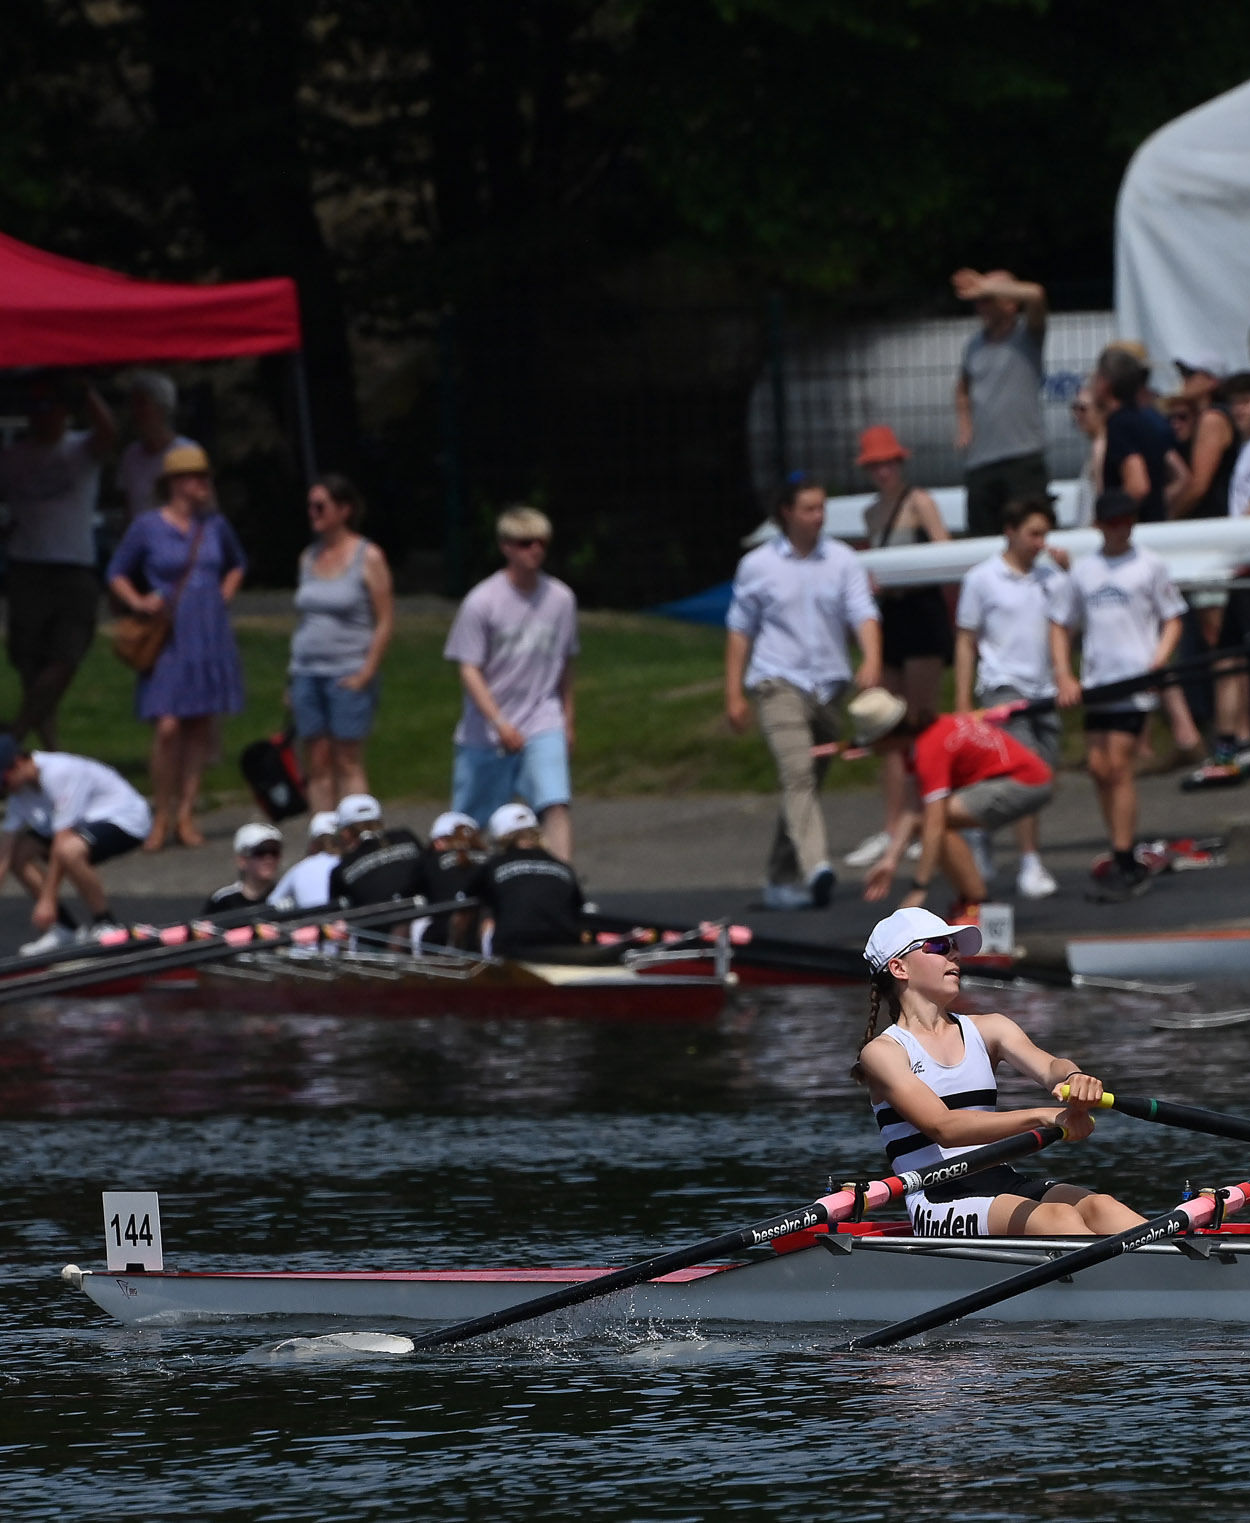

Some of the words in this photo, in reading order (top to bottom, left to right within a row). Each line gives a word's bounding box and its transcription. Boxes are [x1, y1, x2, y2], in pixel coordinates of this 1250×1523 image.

[923, 1161, 969, 1187] CROKER
[110, 1213, 154, 1247] 144
[752, 1211, 818, 1244] besselrc.de
[914, 1203, 979, 1236] Minden
